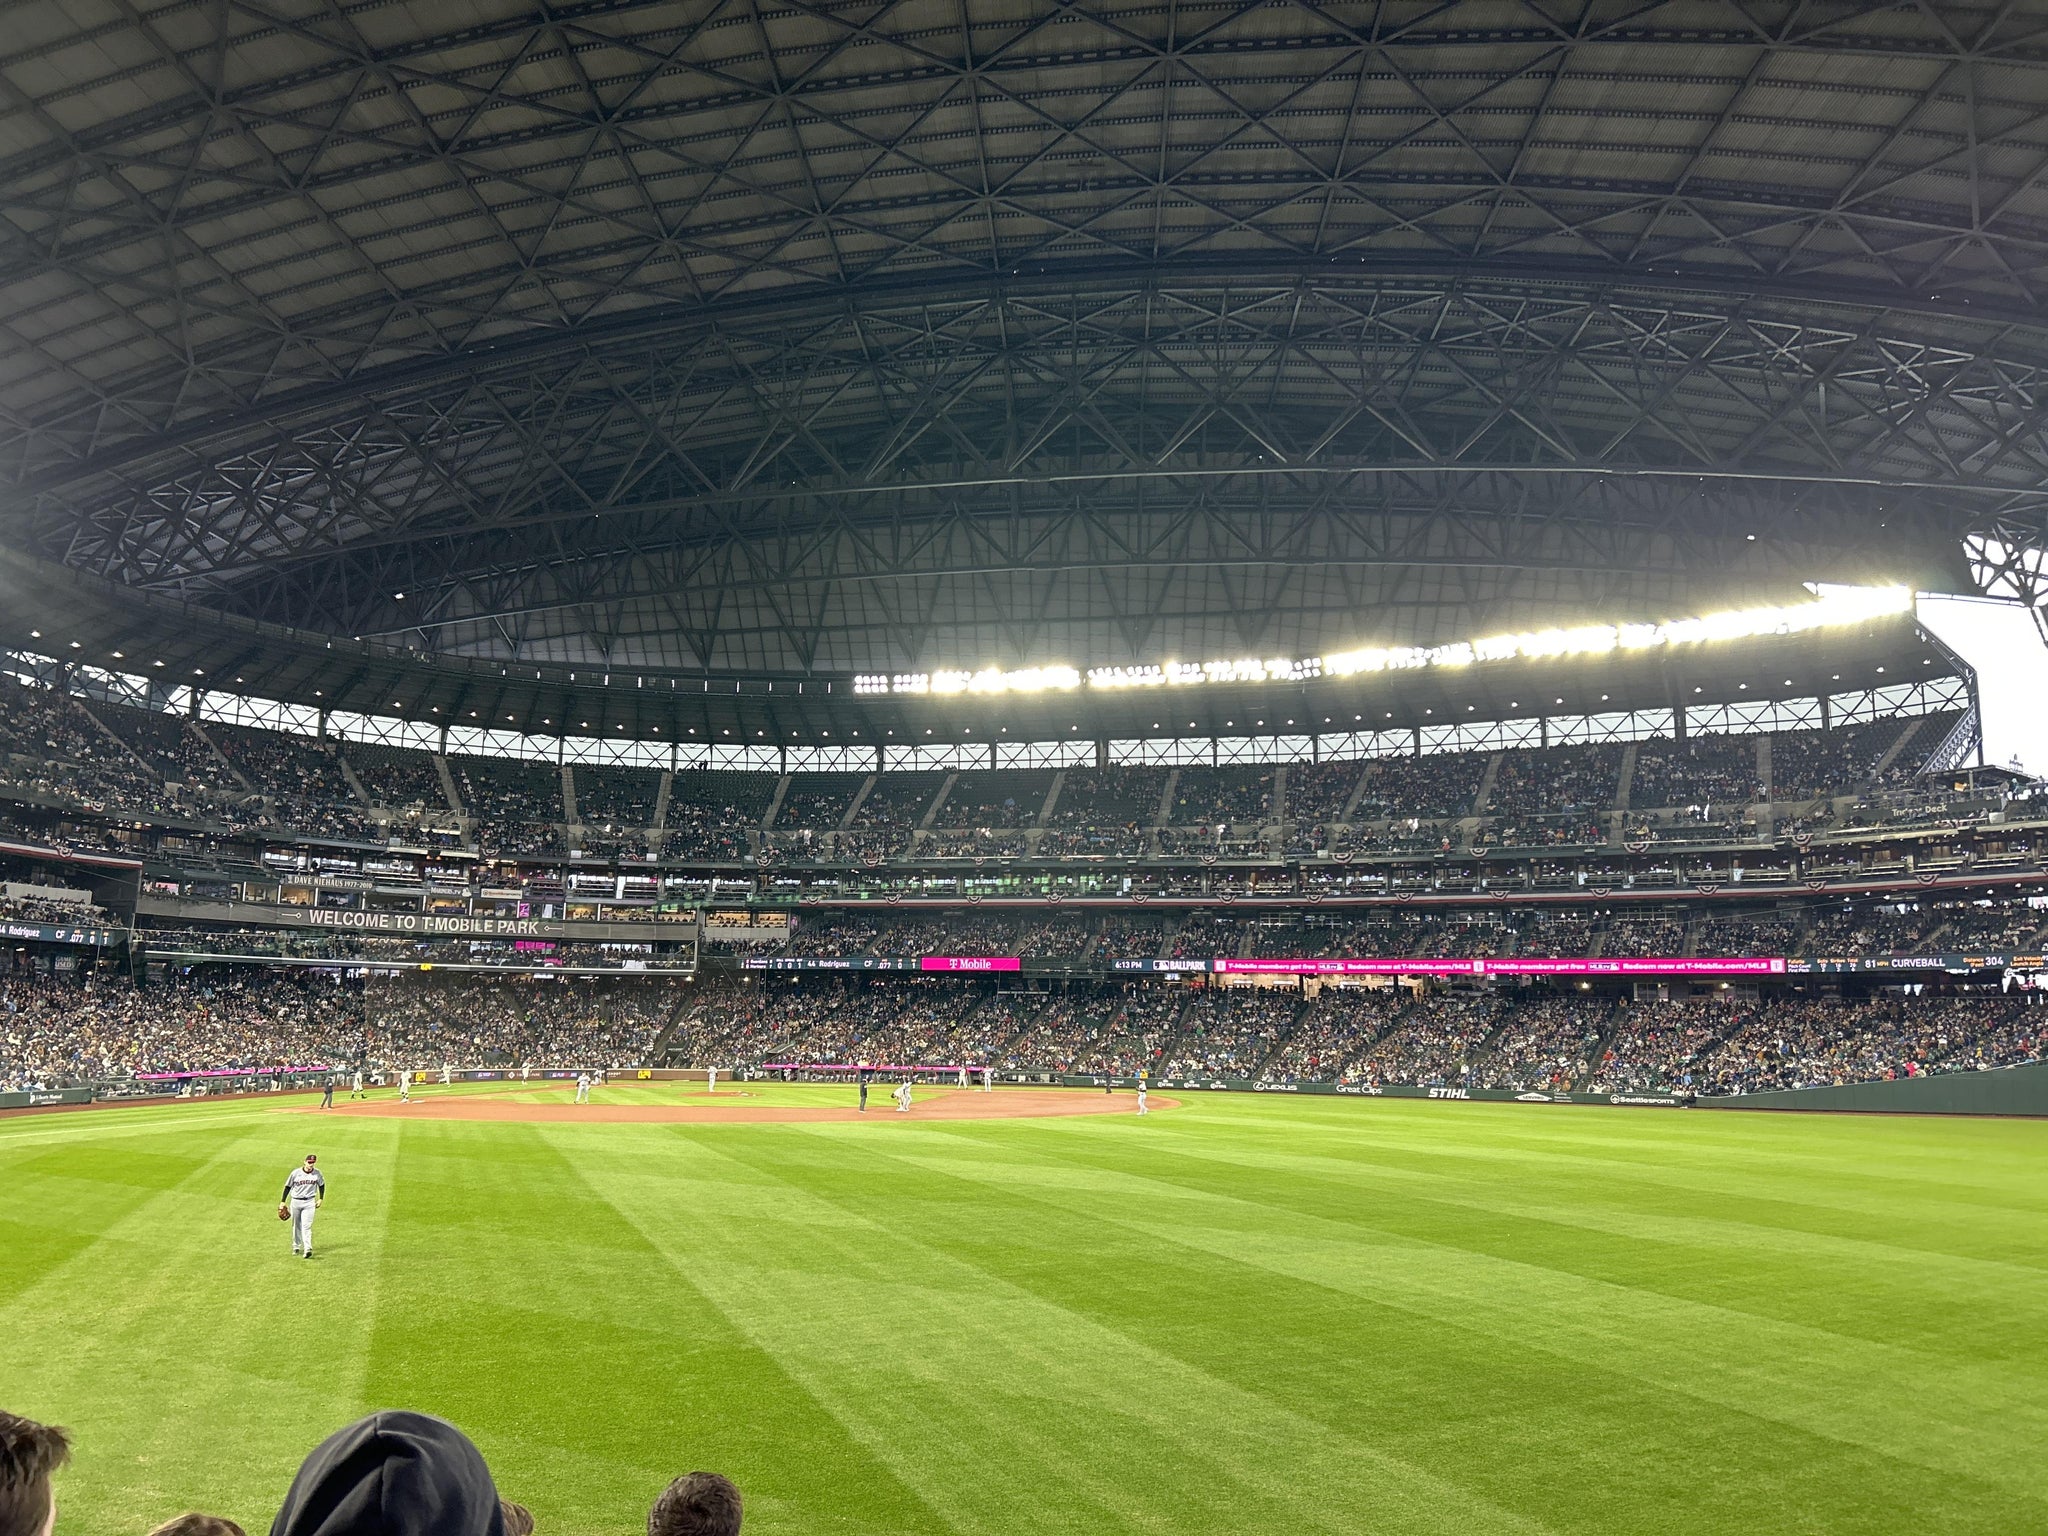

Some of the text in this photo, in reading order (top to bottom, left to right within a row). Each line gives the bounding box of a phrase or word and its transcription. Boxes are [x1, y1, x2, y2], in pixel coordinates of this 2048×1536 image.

[1925, 803, 1948, 813] Deck
[294, 877, 373, 889] DAVE NIEHAUS 1977-2010
[309, 909, 539, 934] WELCOME TO T-MOBILE PARK
[9, 925, 40, 938] Rodríguez
[56, 930, 66, 939] CF
[69, 934, 84, 943] .077
[90, 936, 95, 944] 0
[104, 937, 108, 945] 1
[959, 959, 991, 969] Mobile
[1115, 961, 1142, 969] 6:13 PM
[1170, 961, 1206, 970] BALLPARK
[1865, 960, 1876, 968] 81
[1891, 958, 1946, 967] CURVEBALL
[1985, 956, 2004, 966] 304
[1336, 1084, 1383, 1095] Great Clips
[1428, 1087, 1470, 1099] STIHL
